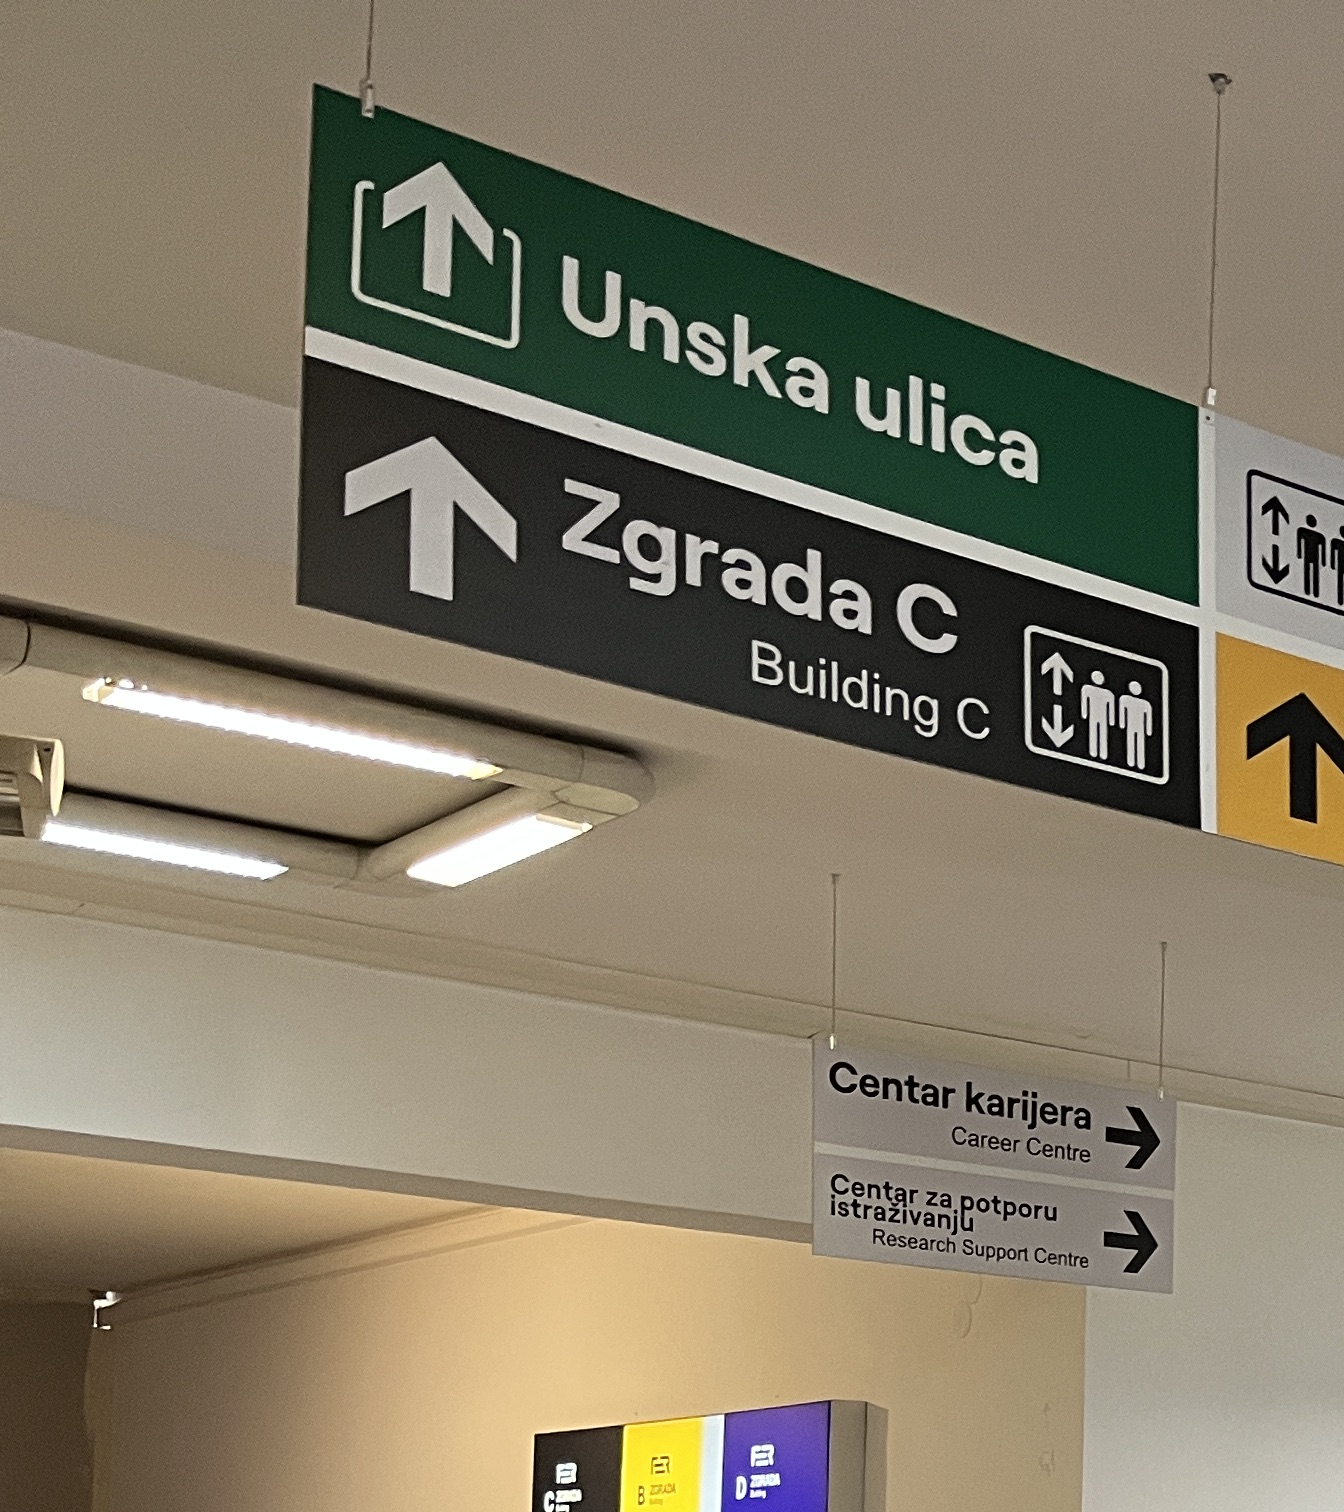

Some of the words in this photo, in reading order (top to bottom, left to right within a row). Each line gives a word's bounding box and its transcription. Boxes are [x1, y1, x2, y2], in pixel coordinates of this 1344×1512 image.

[562, 255, 830, 415] Unska
[855, 374, 1039, 485] ulica
[561, 477, 873, 637] Zgrada
[896, 582, 959, 655] C
[751, 639, 940, 739] Building
[956, 696, 991, 741] C
[829, 1061, 956, 1110] Centar
[965, 1081, 1092, 1130] karijera
[951, 1125, 1020, 1152] Career
[1026, 1137, 1092, 1163] Centre
[830, 1173, 918, 1204] Centar
[926, 1190, 952, 1209] za
[960, 1194, 1058, 1224] potporu
[830, 1195, 974, 1236] istraživanju
[872, 1228, 956, 1254] Research
[962, 1240, 1029, 1264] Support
[1034, 1247, 1089, 1269] Centre
